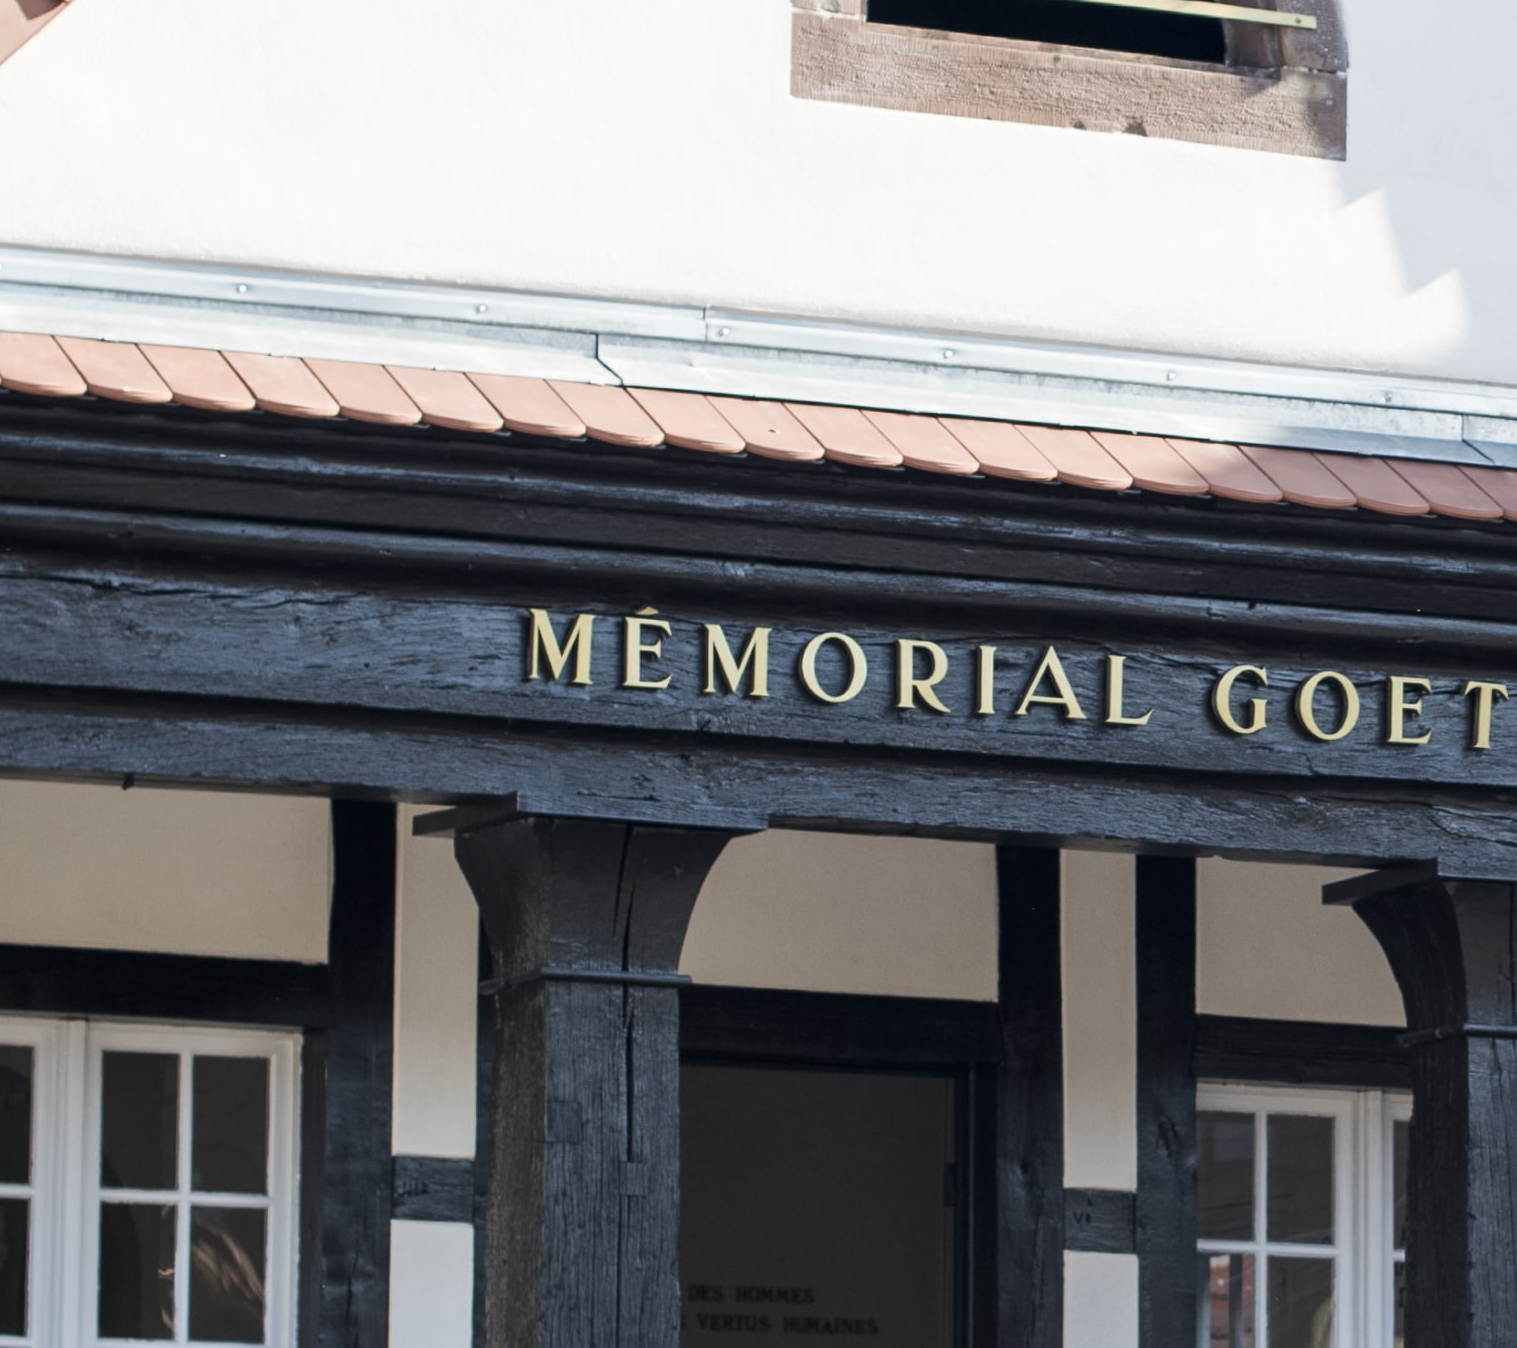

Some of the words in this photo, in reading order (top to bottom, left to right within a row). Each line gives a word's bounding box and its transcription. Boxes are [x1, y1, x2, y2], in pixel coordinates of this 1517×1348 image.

[688, 1284, 724, 1302] DES
[736, 1285, 815, 1304] HOMMES
[698, 1314, 771, 1333] VERTUS
[783, 1316, 879, 1335] HUMAINES
